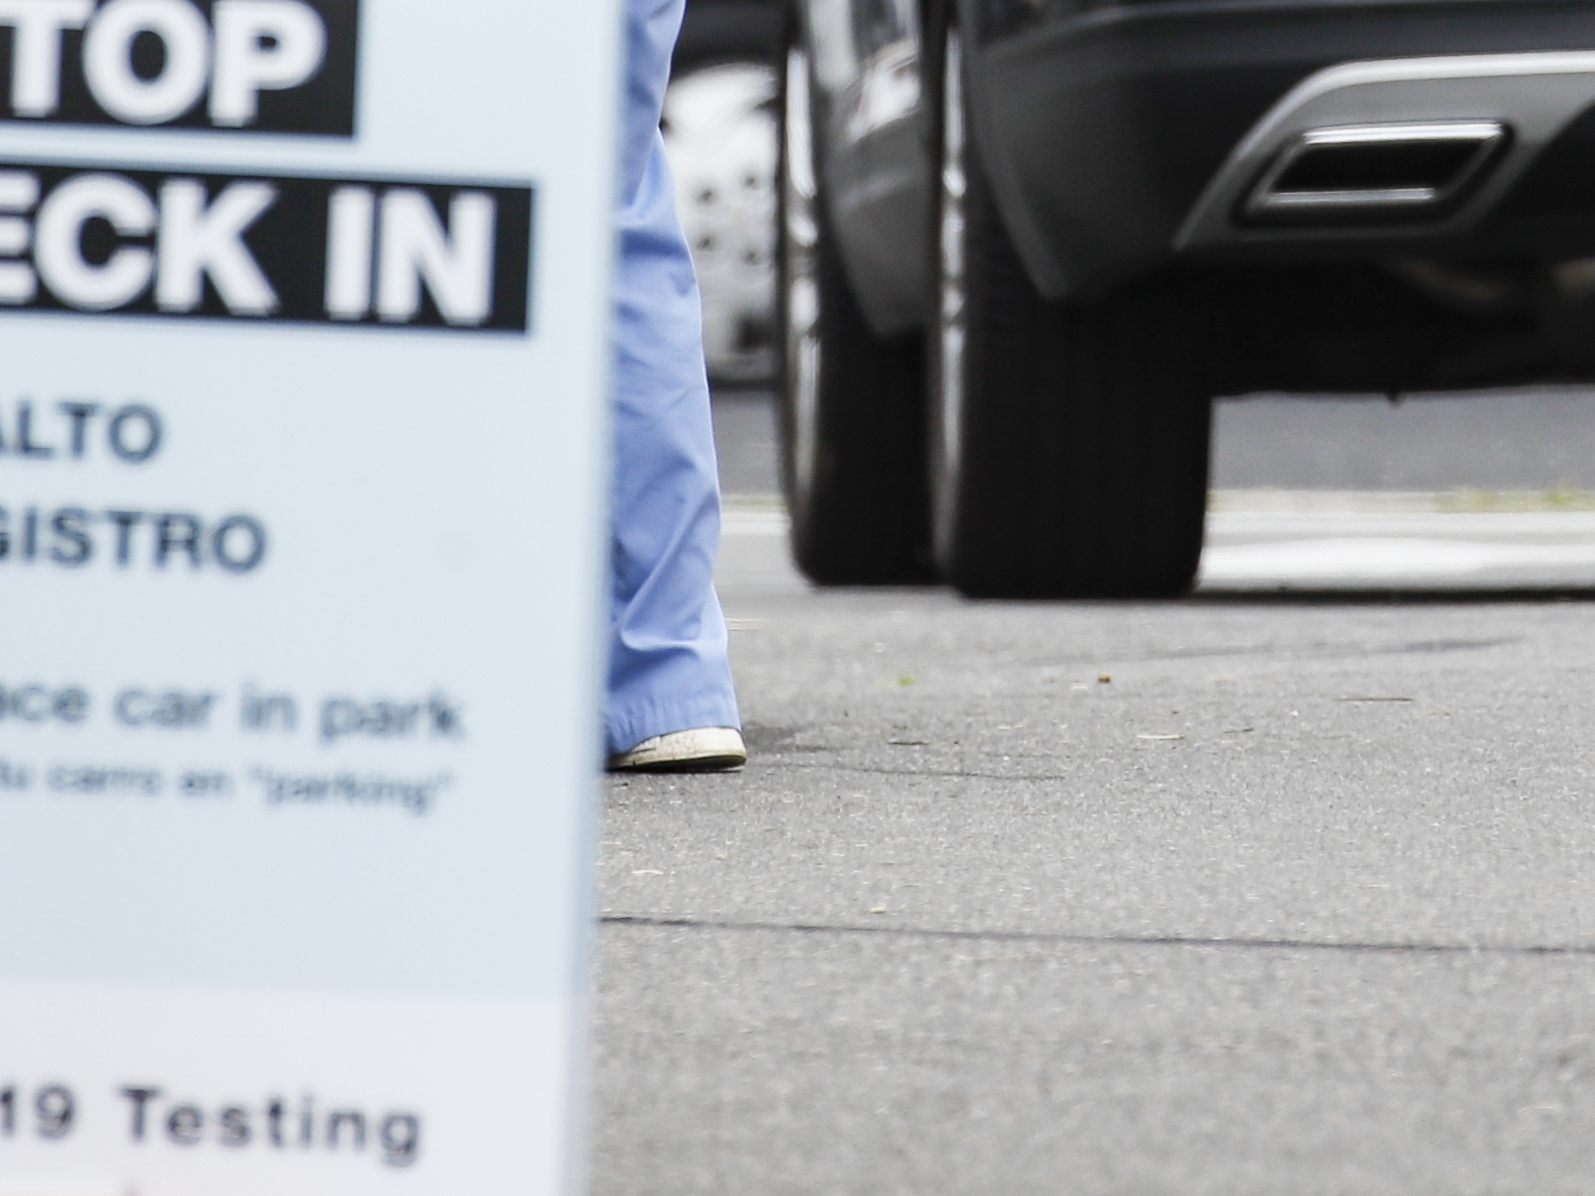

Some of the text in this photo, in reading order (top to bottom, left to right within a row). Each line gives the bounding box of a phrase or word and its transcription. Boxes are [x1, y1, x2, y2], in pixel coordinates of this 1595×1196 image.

[324, 185, 498, 329] IN
[113, 688, 219, 730] car
[239, 678, 298, 735] in
[317, 684, 467, 747] park
[118, 1083, 423, 1168] Testing
